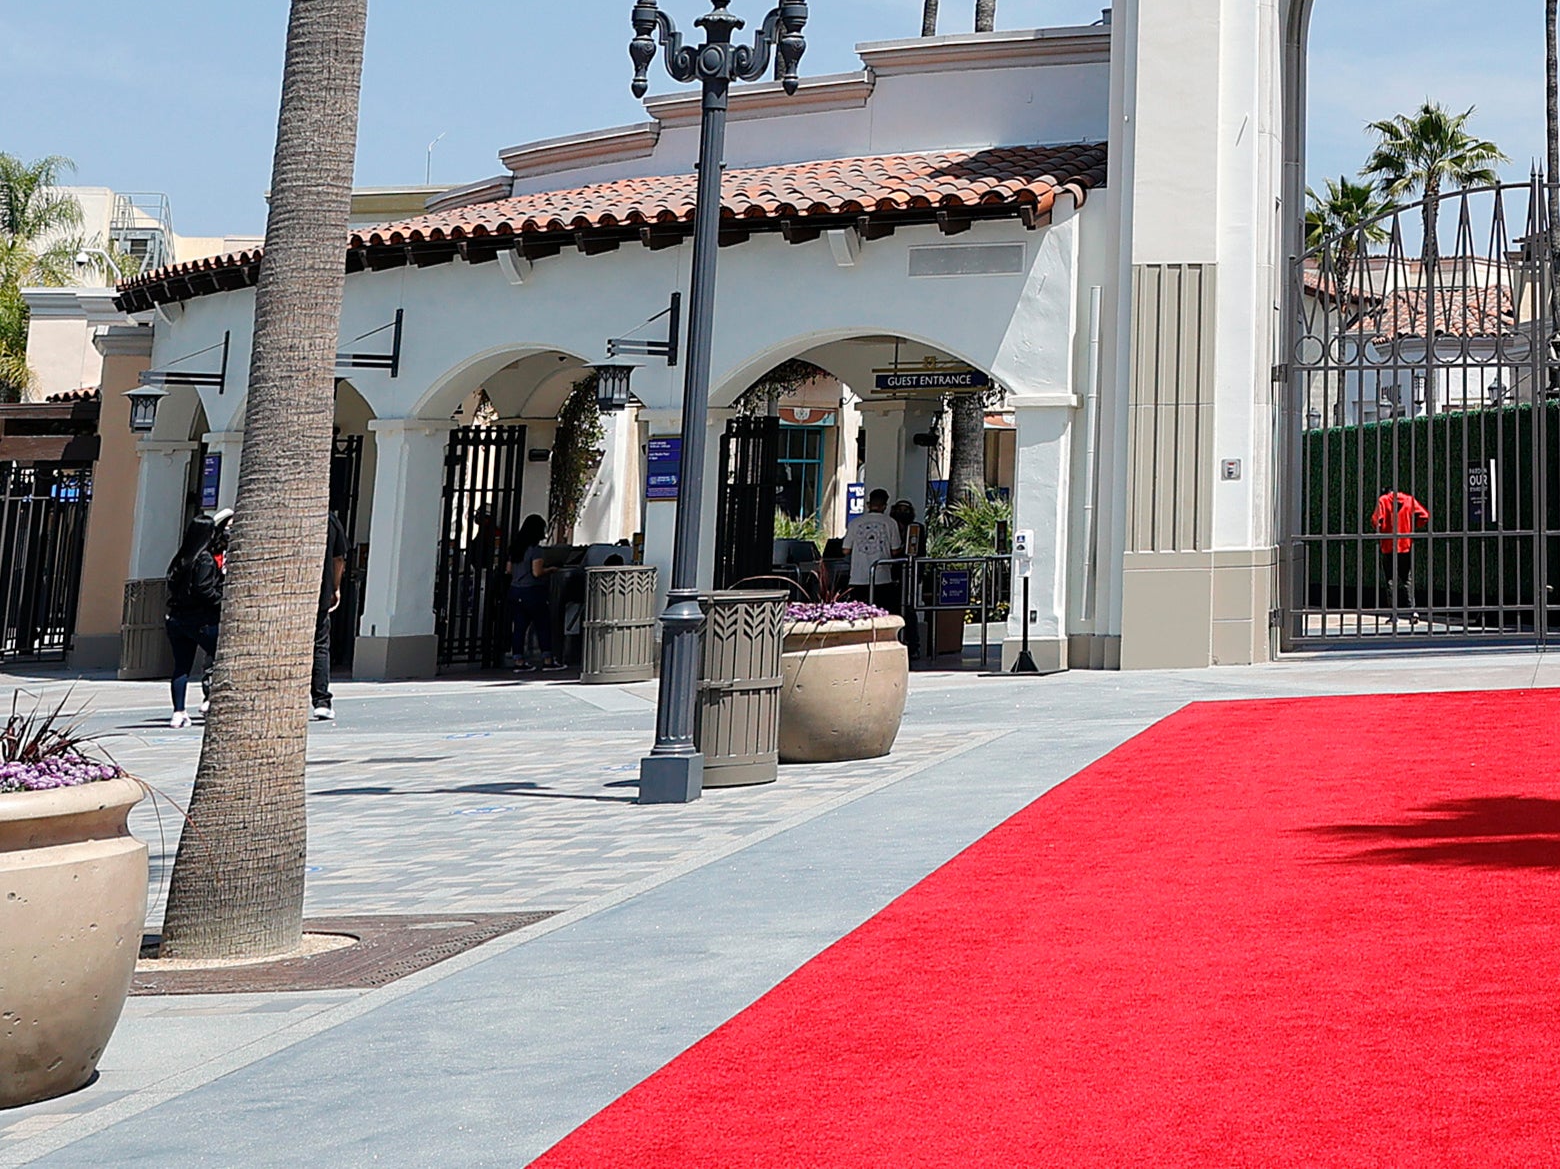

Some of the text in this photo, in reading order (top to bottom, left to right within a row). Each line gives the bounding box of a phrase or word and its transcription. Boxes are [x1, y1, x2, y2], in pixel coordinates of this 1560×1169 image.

[887, 374, 972, 386] GUEST ENTRANCE
[1469, 474, 1488, 486] OUR
